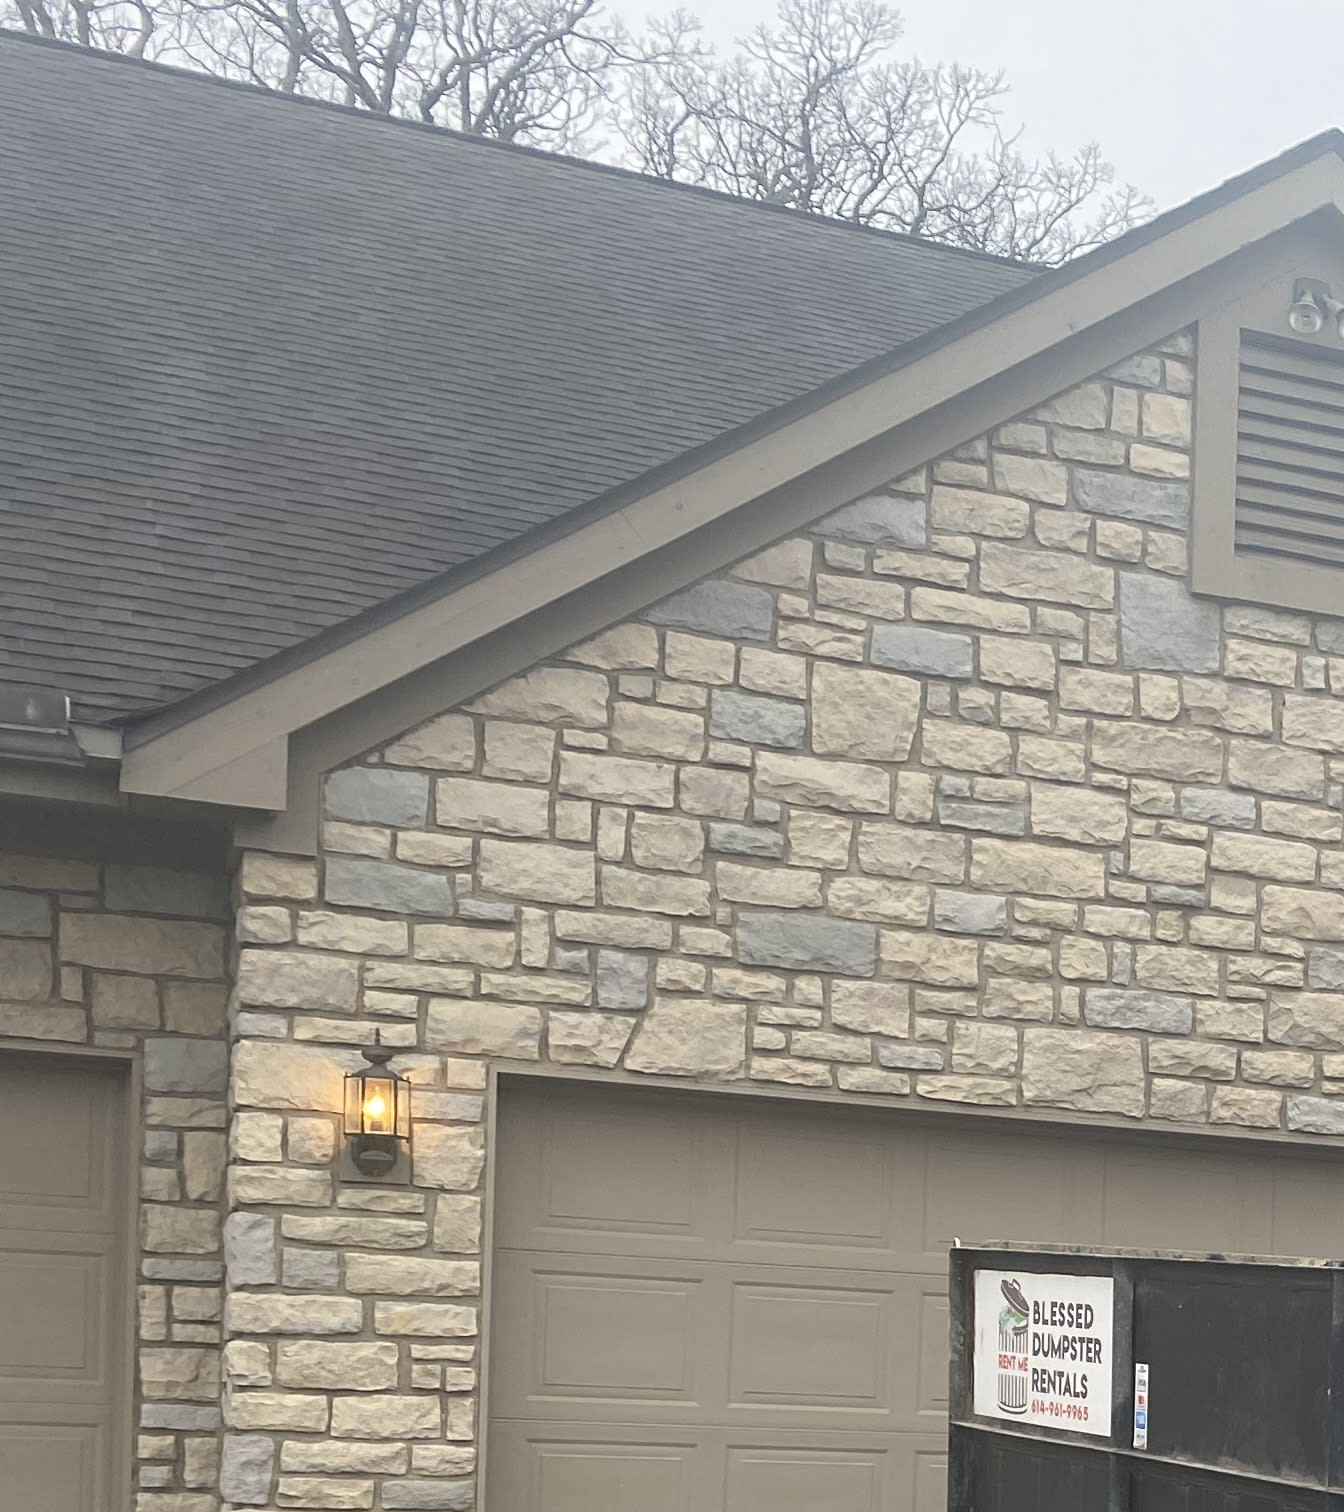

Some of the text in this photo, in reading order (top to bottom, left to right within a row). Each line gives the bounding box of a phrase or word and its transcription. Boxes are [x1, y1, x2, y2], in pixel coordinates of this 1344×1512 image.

[1032, 1300, 1094, 1329] BLESSED
[998, 1353, 1029, 1372] RENT ME
[1031, 1332, 1102, 1364] DUMPSTER
[1031, 1367, 1089, 1399] RENTALS
[1031, 1399, 1089, 1422] 614-961-9965
